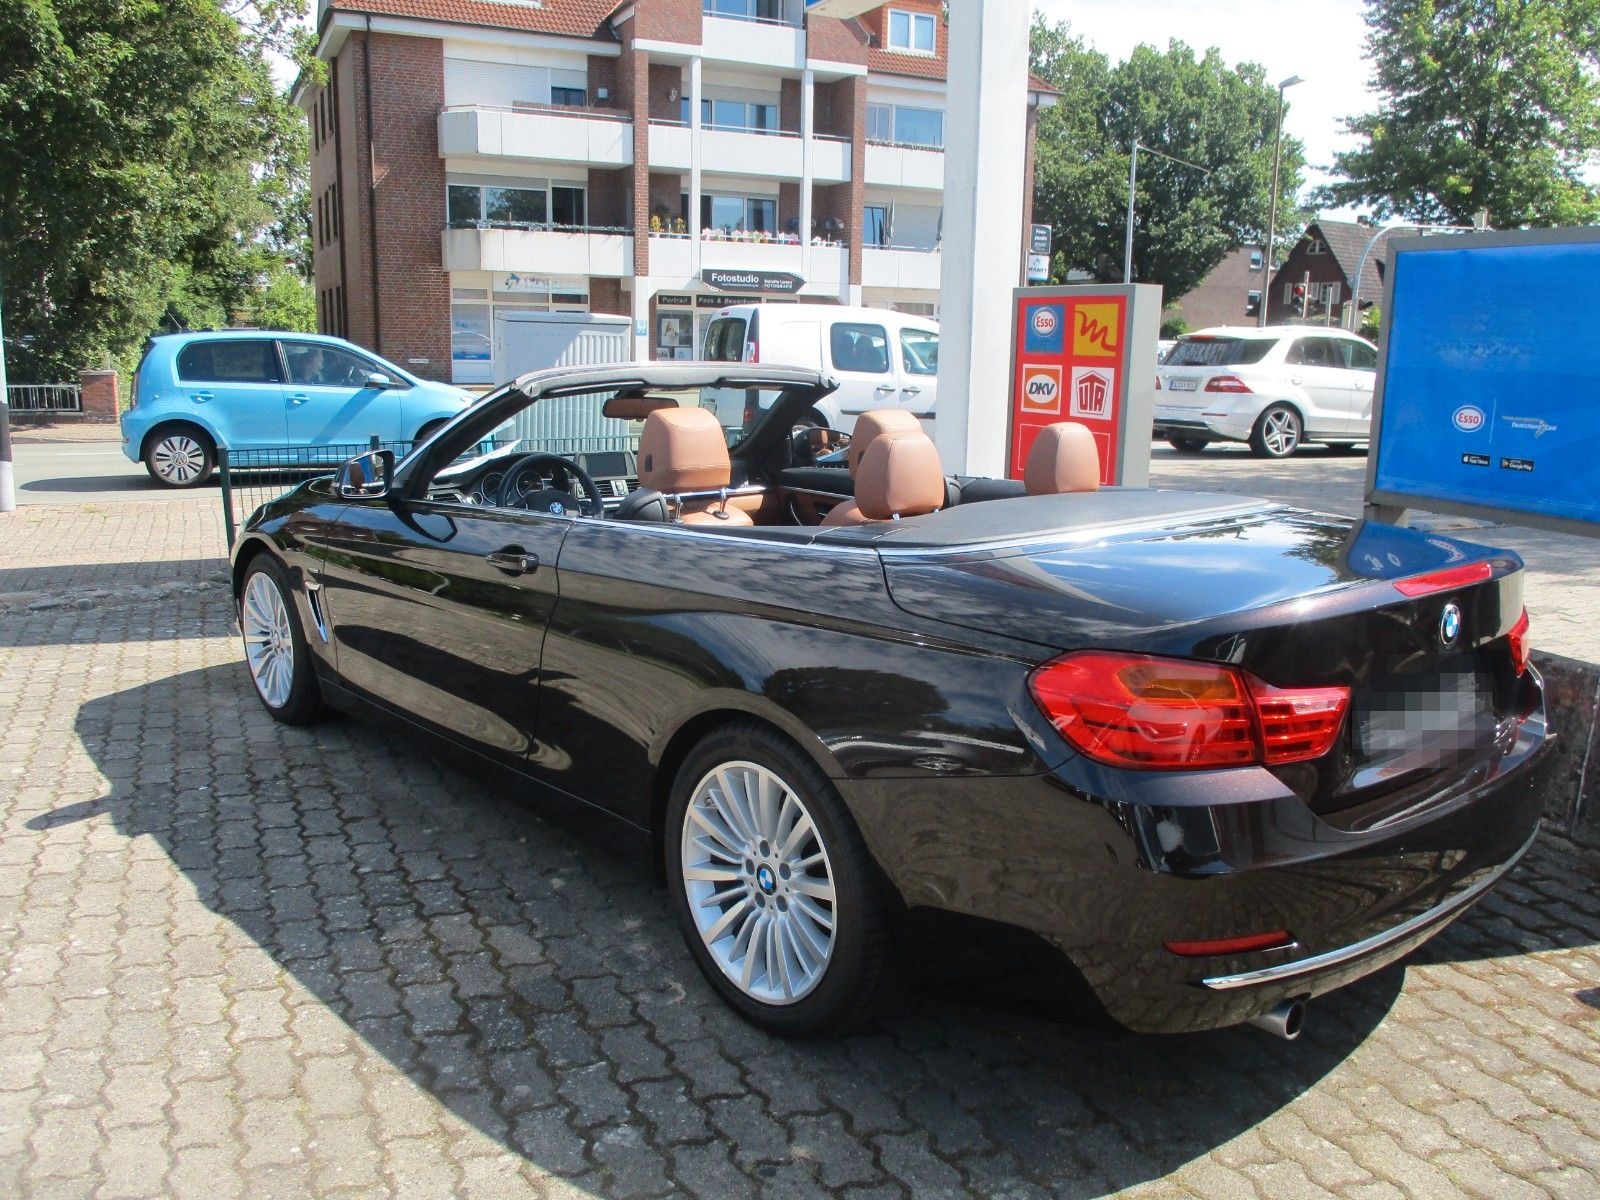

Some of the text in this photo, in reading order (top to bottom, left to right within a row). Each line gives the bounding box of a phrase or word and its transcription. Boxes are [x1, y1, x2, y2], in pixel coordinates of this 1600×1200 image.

[711, 273, 759, 283] Fotostudio
[662, 296, 688, 304] Portrait
[1036, 316, 1054, 328] Esso
[1028, 382, 1055, 396] DKV
[1078, 373, 1107, 412] UTA
[1458, 413, 1479, 424] Esso
